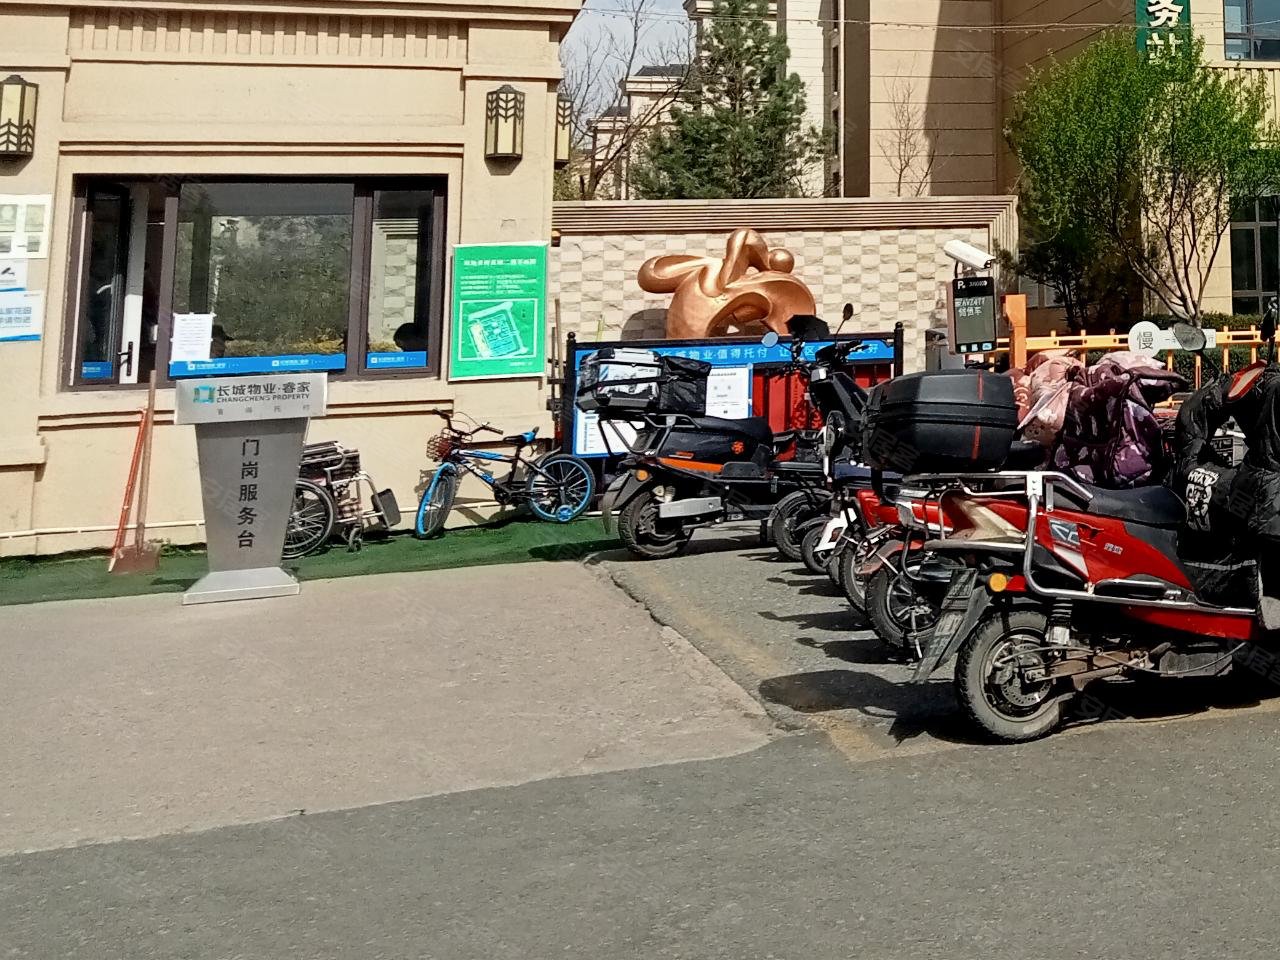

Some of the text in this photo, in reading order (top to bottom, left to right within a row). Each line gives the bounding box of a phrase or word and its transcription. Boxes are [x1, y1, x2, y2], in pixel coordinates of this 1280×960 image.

[271, 393, 311, 402] PROPERTY
[237, 439, 260, 549] 门岗服务台
